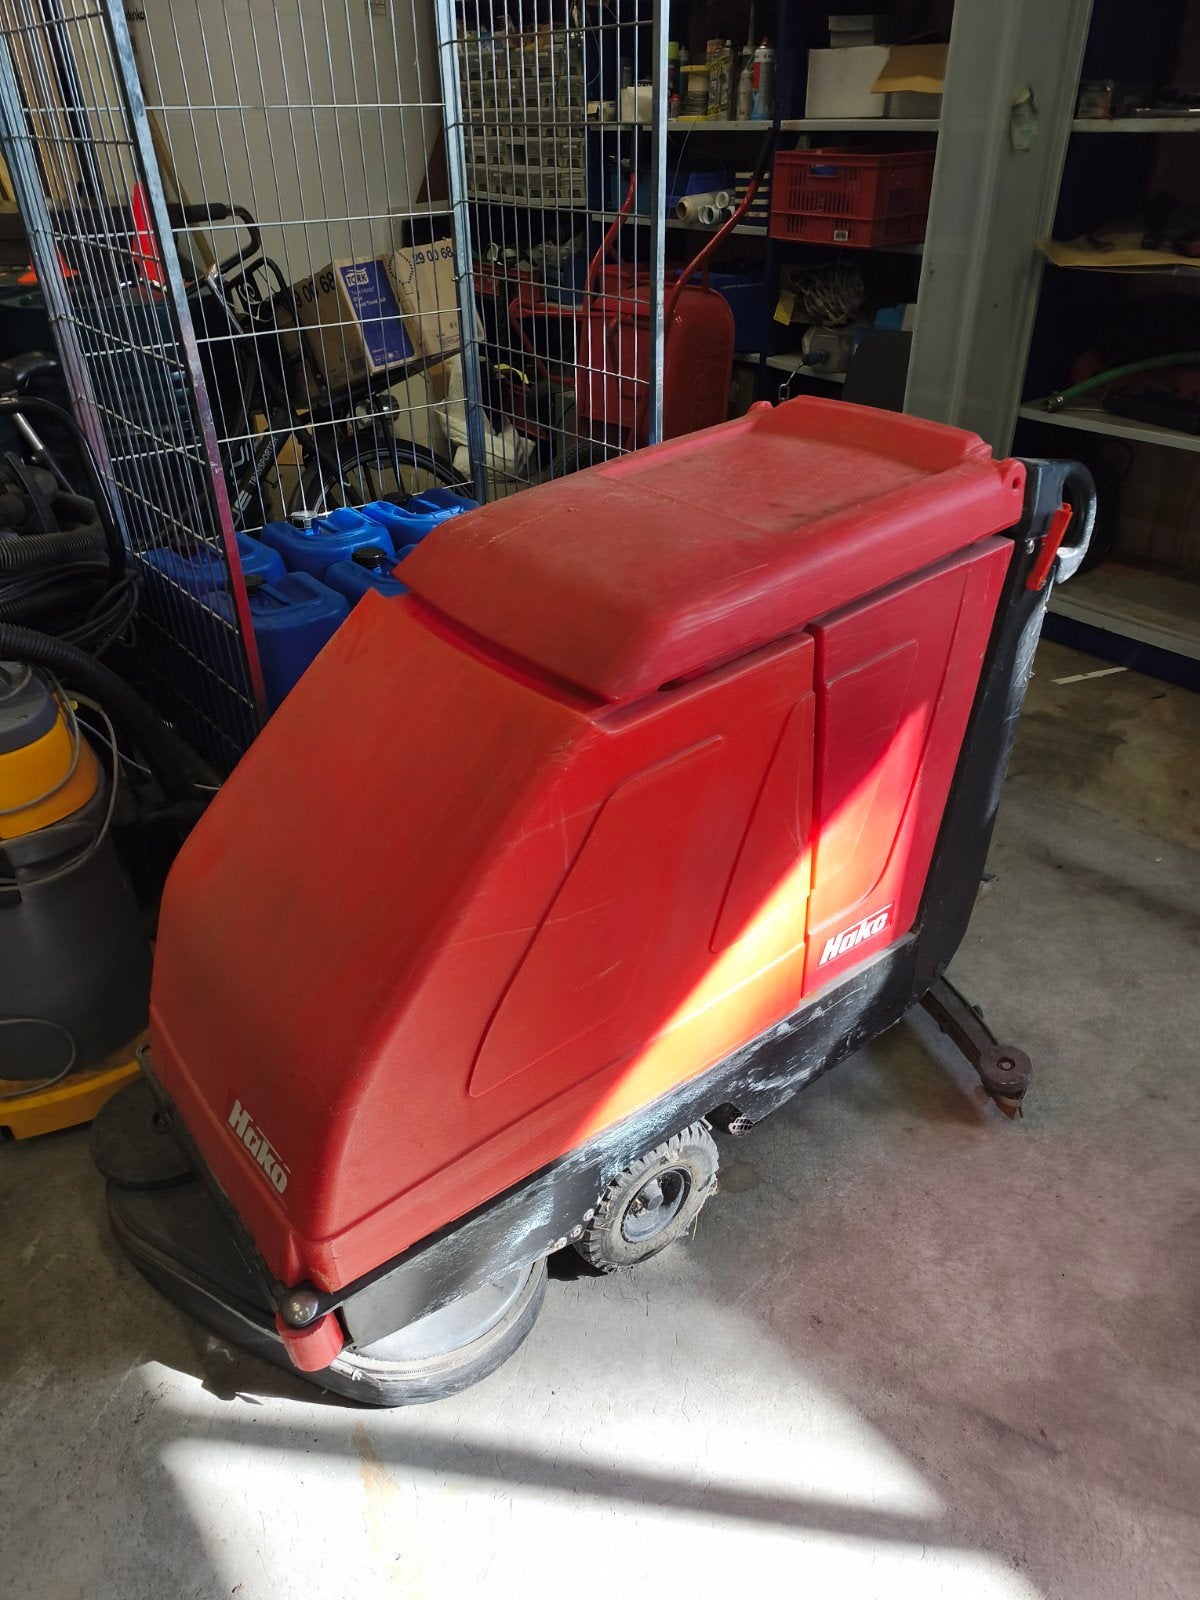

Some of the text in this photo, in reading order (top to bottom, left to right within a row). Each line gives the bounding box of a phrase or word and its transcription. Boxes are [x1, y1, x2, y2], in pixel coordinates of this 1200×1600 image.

[440, 246, 454, 259] 68
[320, 271, 336, 294] 68
[345, 271, 369, 286] TORK
[818, 911, 889, 967] Hako
[228, 1099, 288, 1194] Hako
